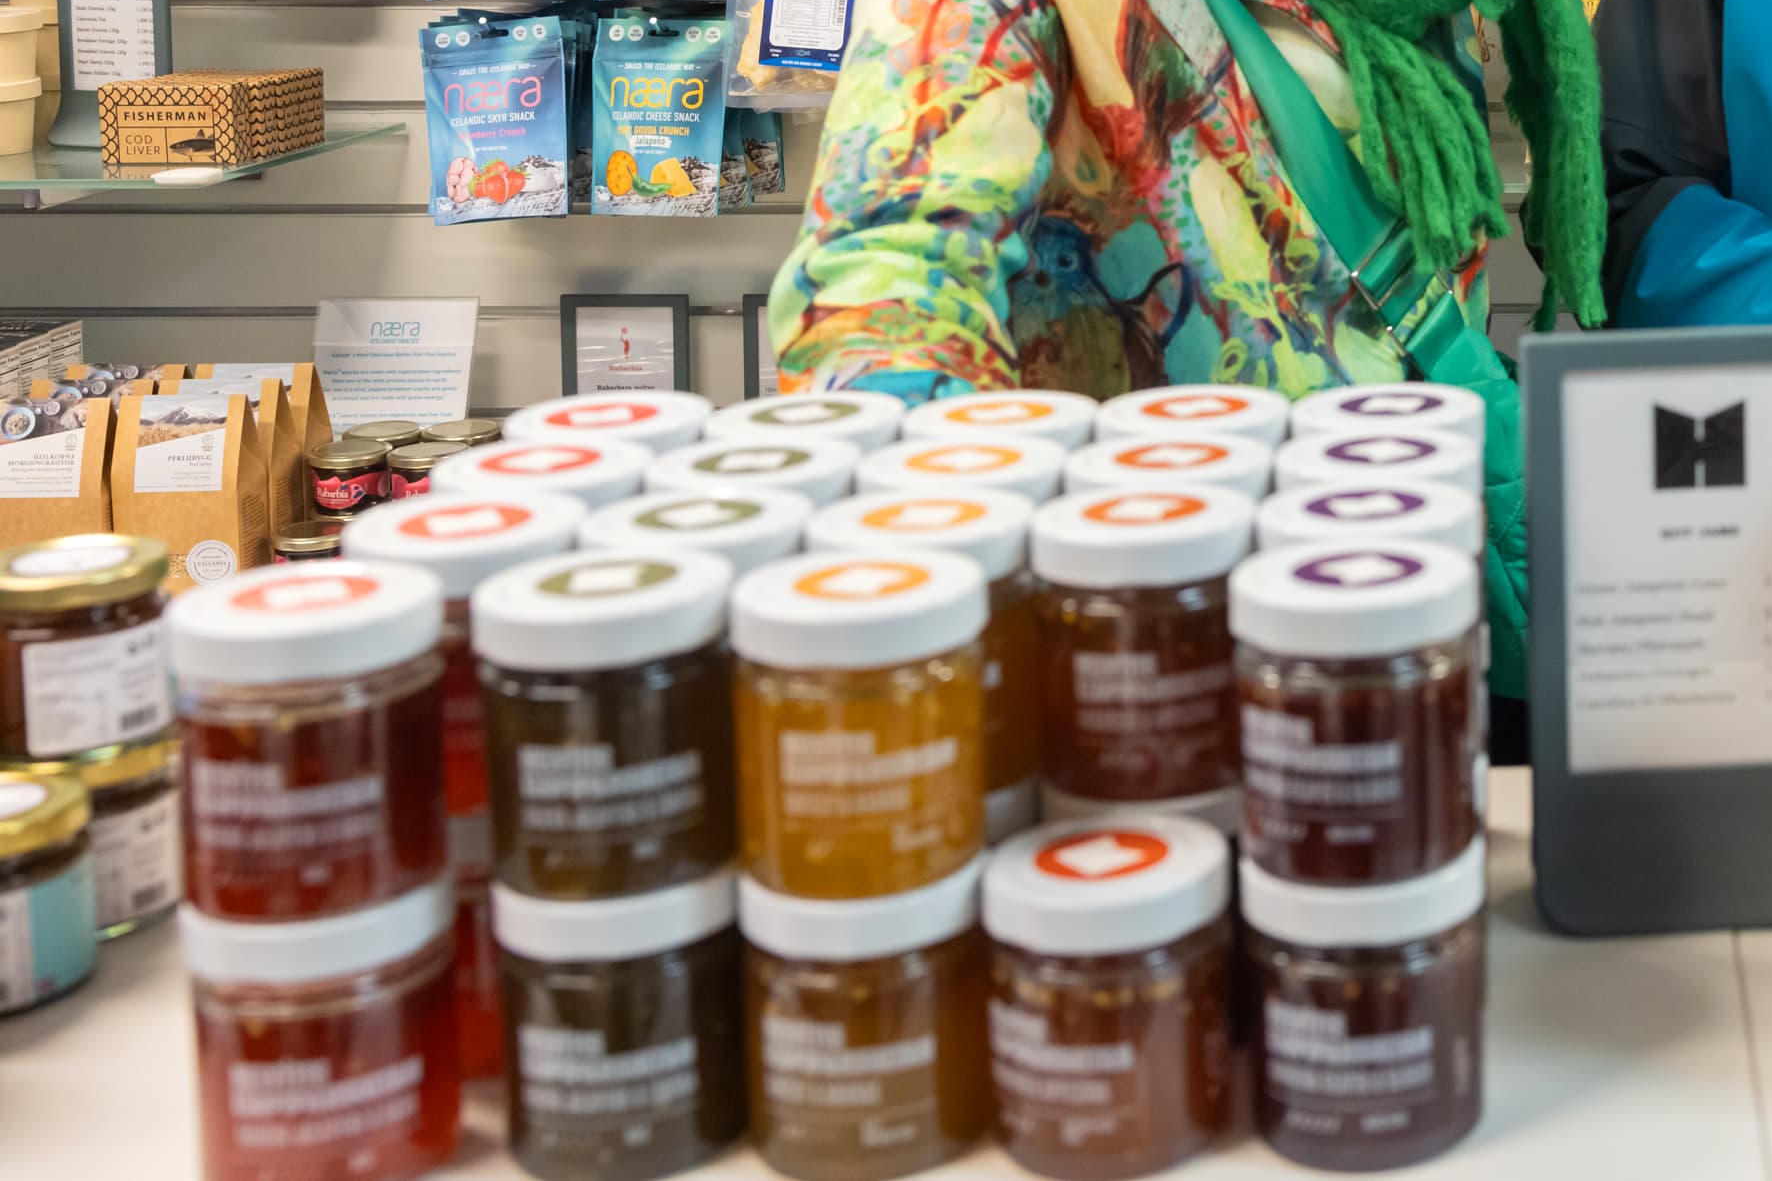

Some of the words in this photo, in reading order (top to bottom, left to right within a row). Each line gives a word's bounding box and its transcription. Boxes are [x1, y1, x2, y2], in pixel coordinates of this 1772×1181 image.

[444, 75, 541, 115] næra
[610, 76, 704, 109] næra
[124, 111, 207, 121] FISHERMAN
[487, 113, 507, 123] SKYR
[509, 111, 535, 122] SNACK
[645, 112, 672, 122] CHEESE
[674, 112, 700, 122] SNACK
[125, 134, 153, 145] COD
[126, 145, 161, 155] LIVER
[371, 321, 421, 337] næra
